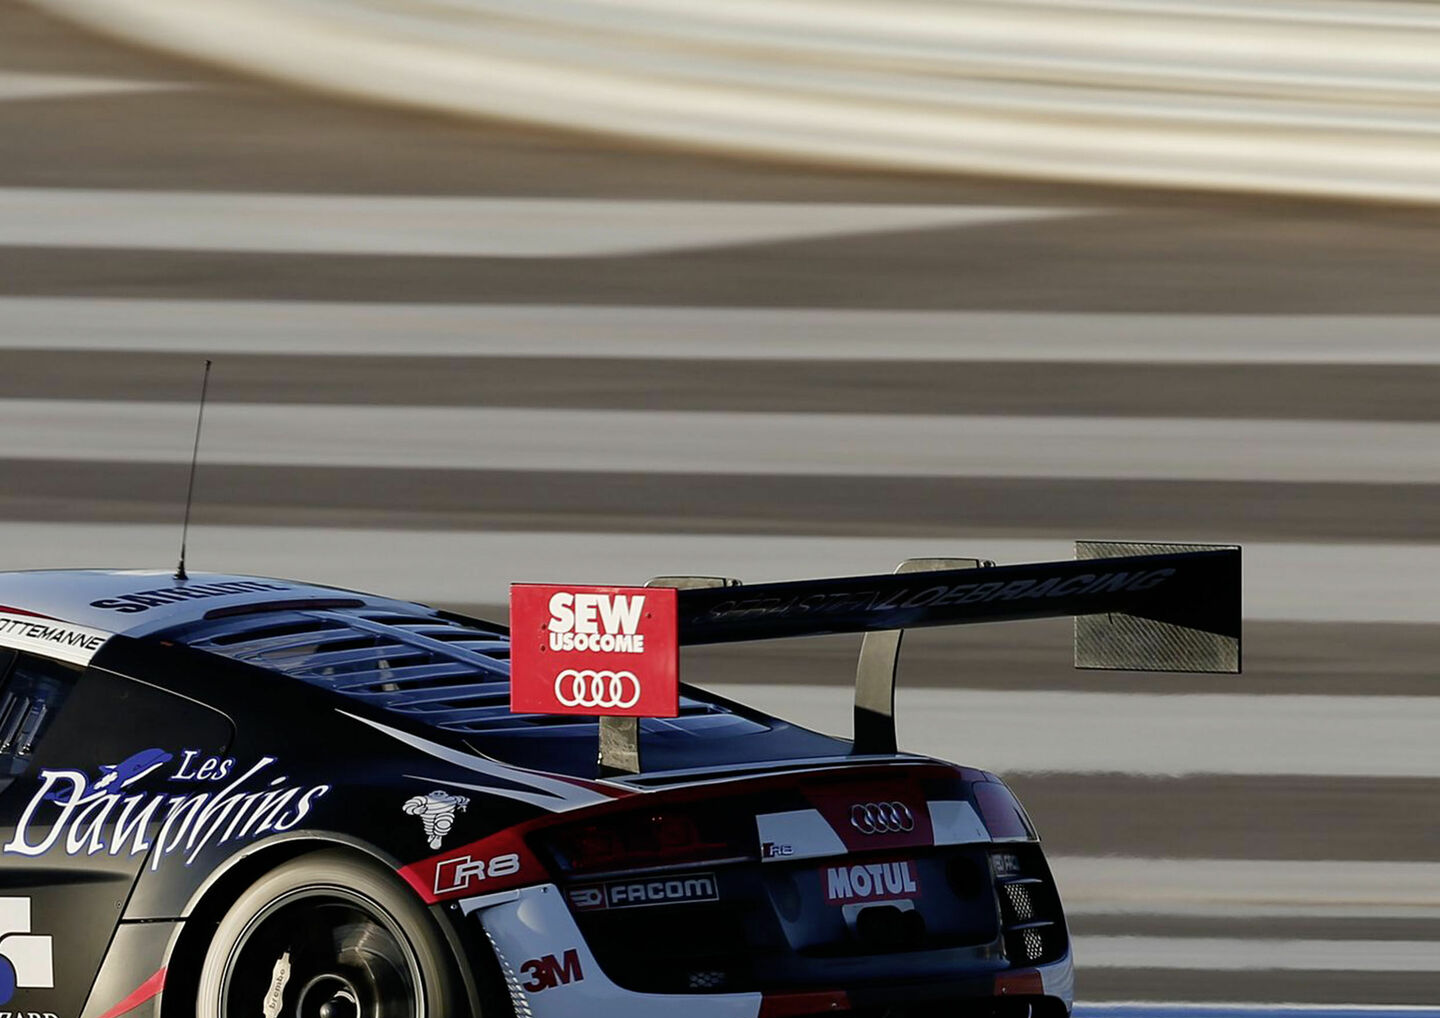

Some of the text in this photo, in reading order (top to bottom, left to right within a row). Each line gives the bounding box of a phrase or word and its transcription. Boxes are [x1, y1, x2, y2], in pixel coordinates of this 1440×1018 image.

[547, 592, 646, 635] SEW
[548, 632, 645, 654] USOCOME
[170, 749, 234, 781] Les
[453, 853, 520, 886] R8
[826, 860, 917, 900] MOTUL
[610, 878, 714, 904] FACOM
[268, 967, 286, 1010] brembo
[519, 949, 585, 994] 3M
